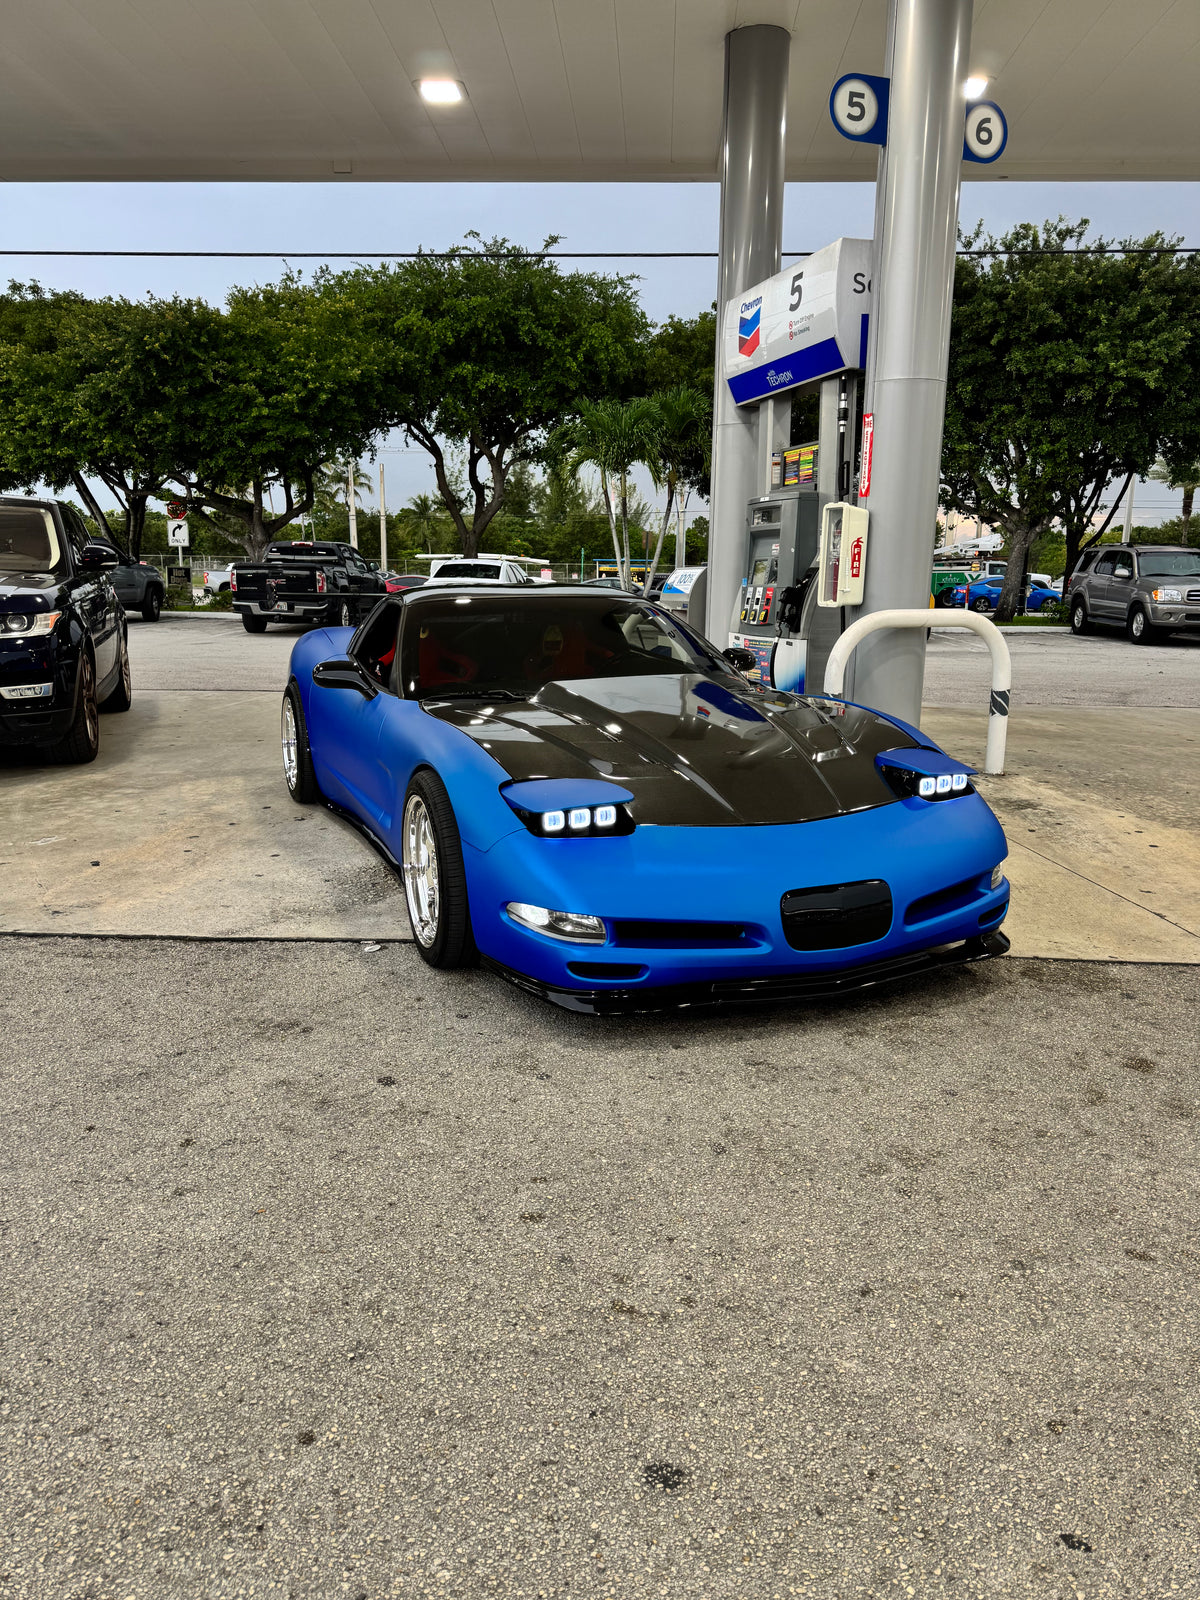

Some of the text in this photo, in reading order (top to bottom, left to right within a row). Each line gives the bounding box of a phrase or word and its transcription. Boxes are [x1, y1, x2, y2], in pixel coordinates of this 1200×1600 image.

[846, 91, 866, 122] 5
[975, 117, 993, 146] 6
[740, 296, 763, 314] Chevron
[788, 271, 804, 312] 5
[766, 370, 794, 387] TECHRON
[853, 547, 861, 575] FIRE
[941, 574, 960, 584] xfinity
